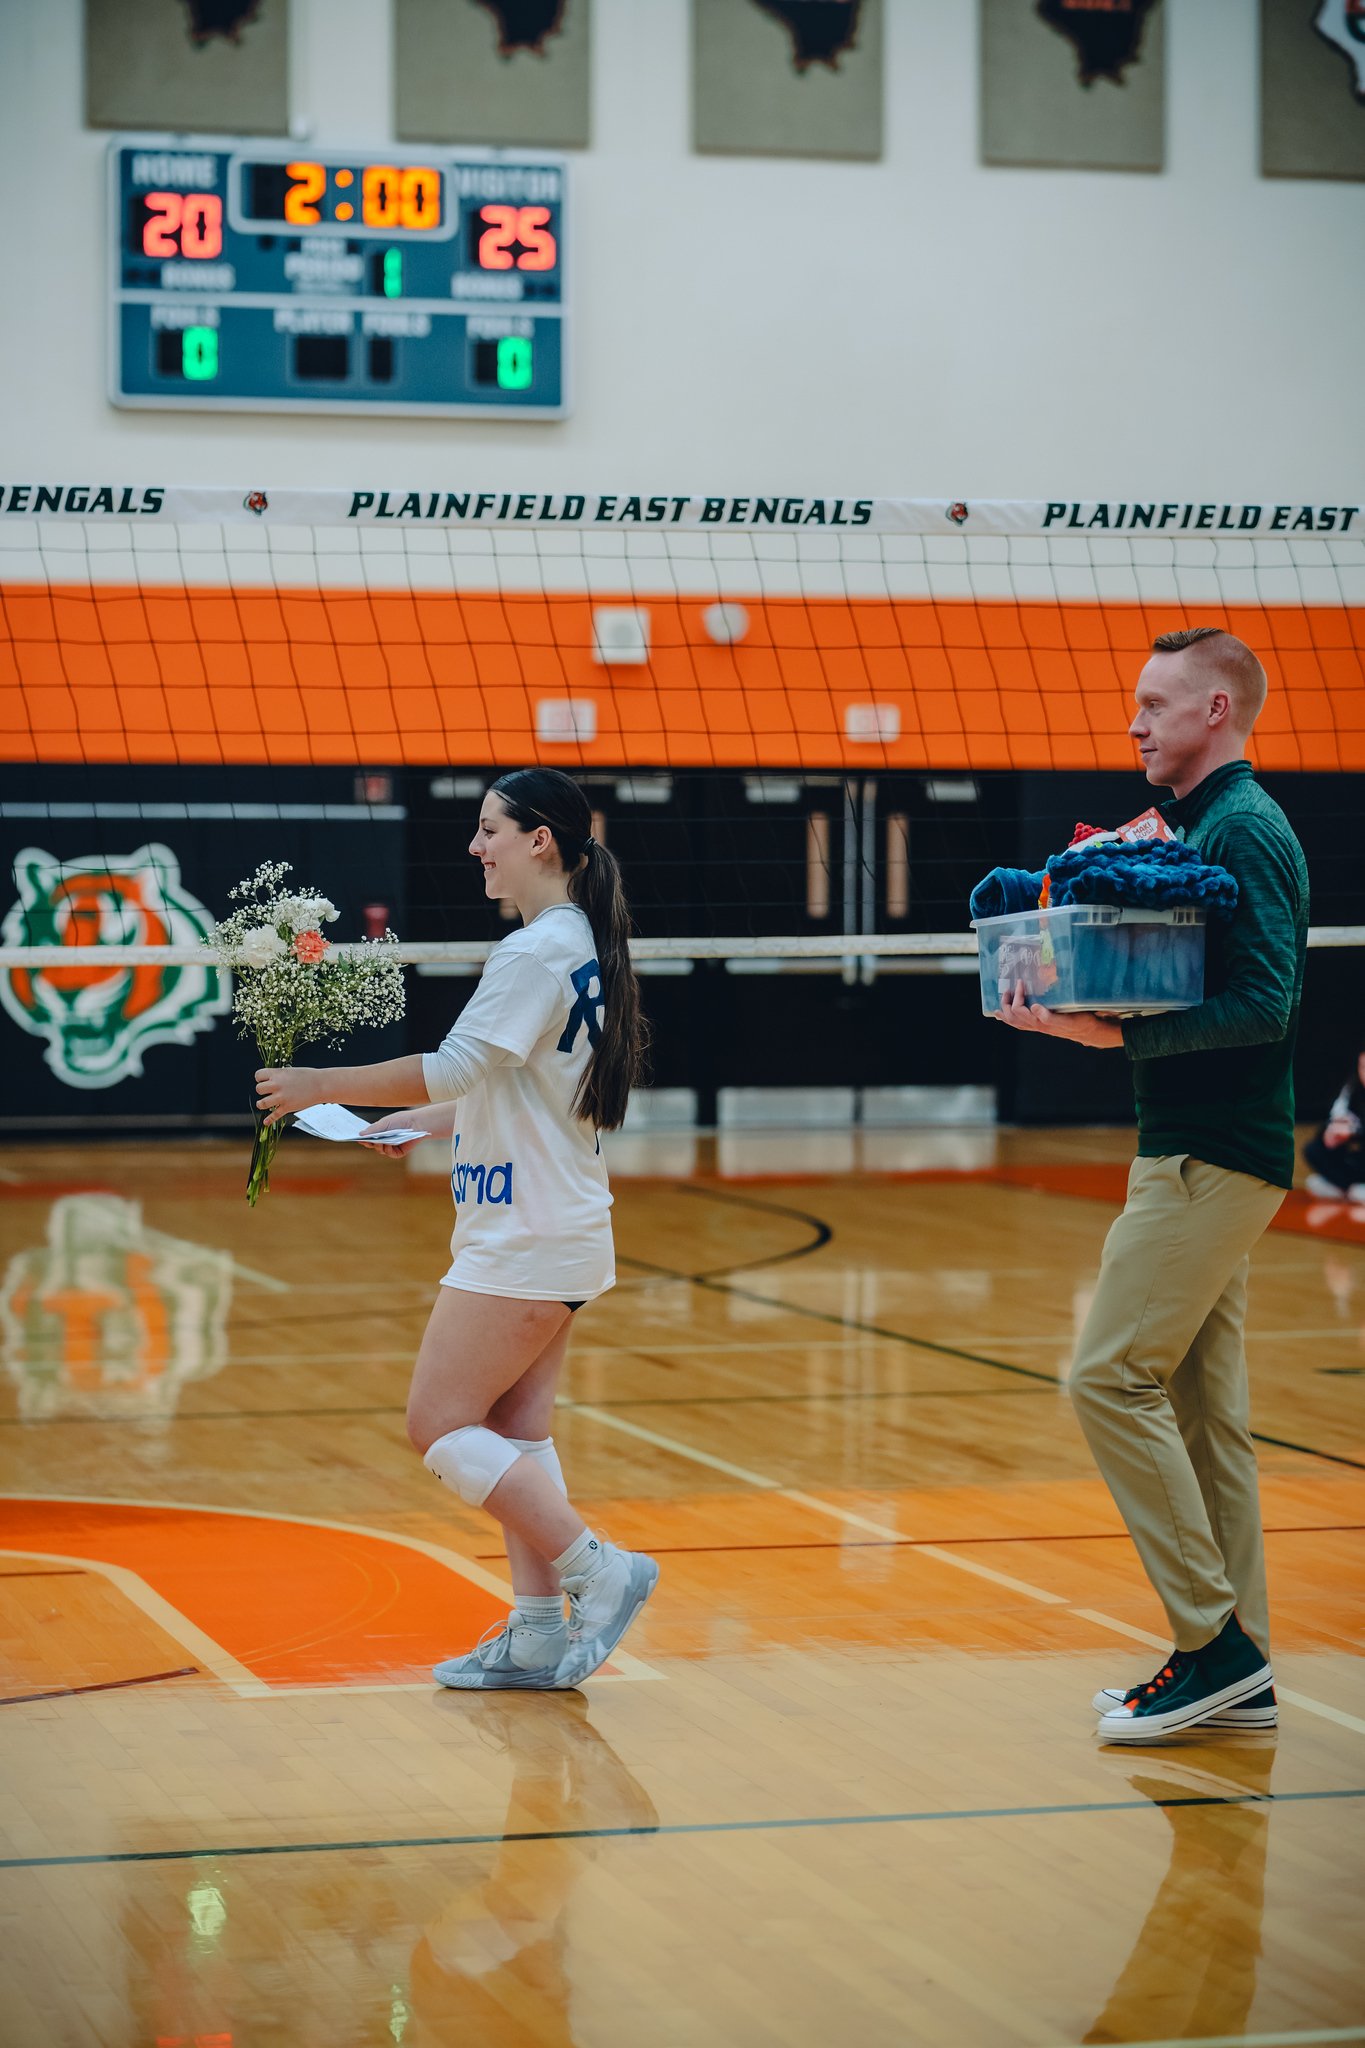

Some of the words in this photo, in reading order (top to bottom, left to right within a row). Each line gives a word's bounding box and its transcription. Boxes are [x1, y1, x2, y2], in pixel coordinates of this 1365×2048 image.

[285, 162, 440, 230] 2:00
[143, 192, 222, 259] 20
[479, 205, 556, 271] 25
[384, 248, 402, 299] 1
[182, 325, 218, 381] 0
[497, 336, 533, 390] 0
[0, 485, 165, 514] ENGALS
[348, 492, 586, 521] PLAINFIELD
[594, 496, 691, 522] EAST
[699, 498, 873, 525] BENGALS
[1042, 503, 1262, 530] PLAINFIELD
[1269, 506, 1359, 532] EAST
